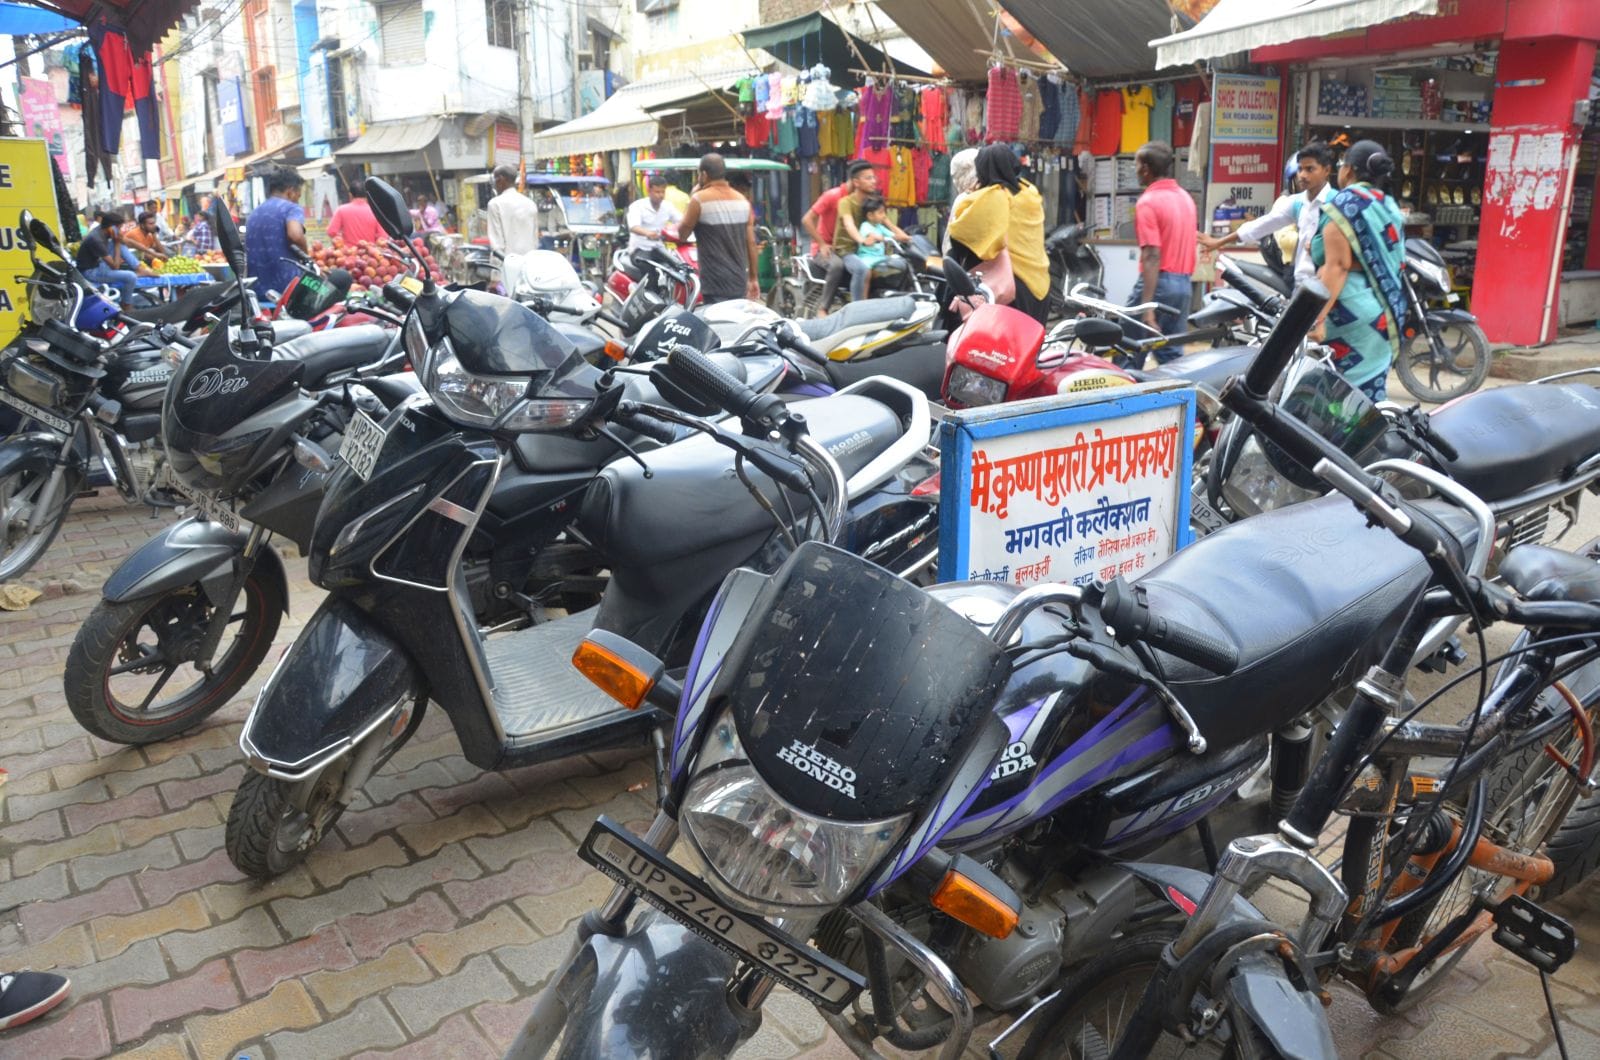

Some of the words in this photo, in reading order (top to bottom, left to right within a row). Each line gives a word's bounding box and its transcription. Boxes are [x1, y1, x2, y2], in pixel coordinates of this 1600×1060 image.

[1230, 187, 1253, 200] SHOE
[1073, 377, 1106, 387] HERO
[1005, 507, 1073, 554] भगवती
[776, 746, 857, 799] HONDA
[790, 739, 857, 783] HERO
[990, 754, 1037, 780] NDA
[1173, 784, 1213, 812] CD
[628, 855, 666, 884] UP
[758, 941, 836, 992] 8221
